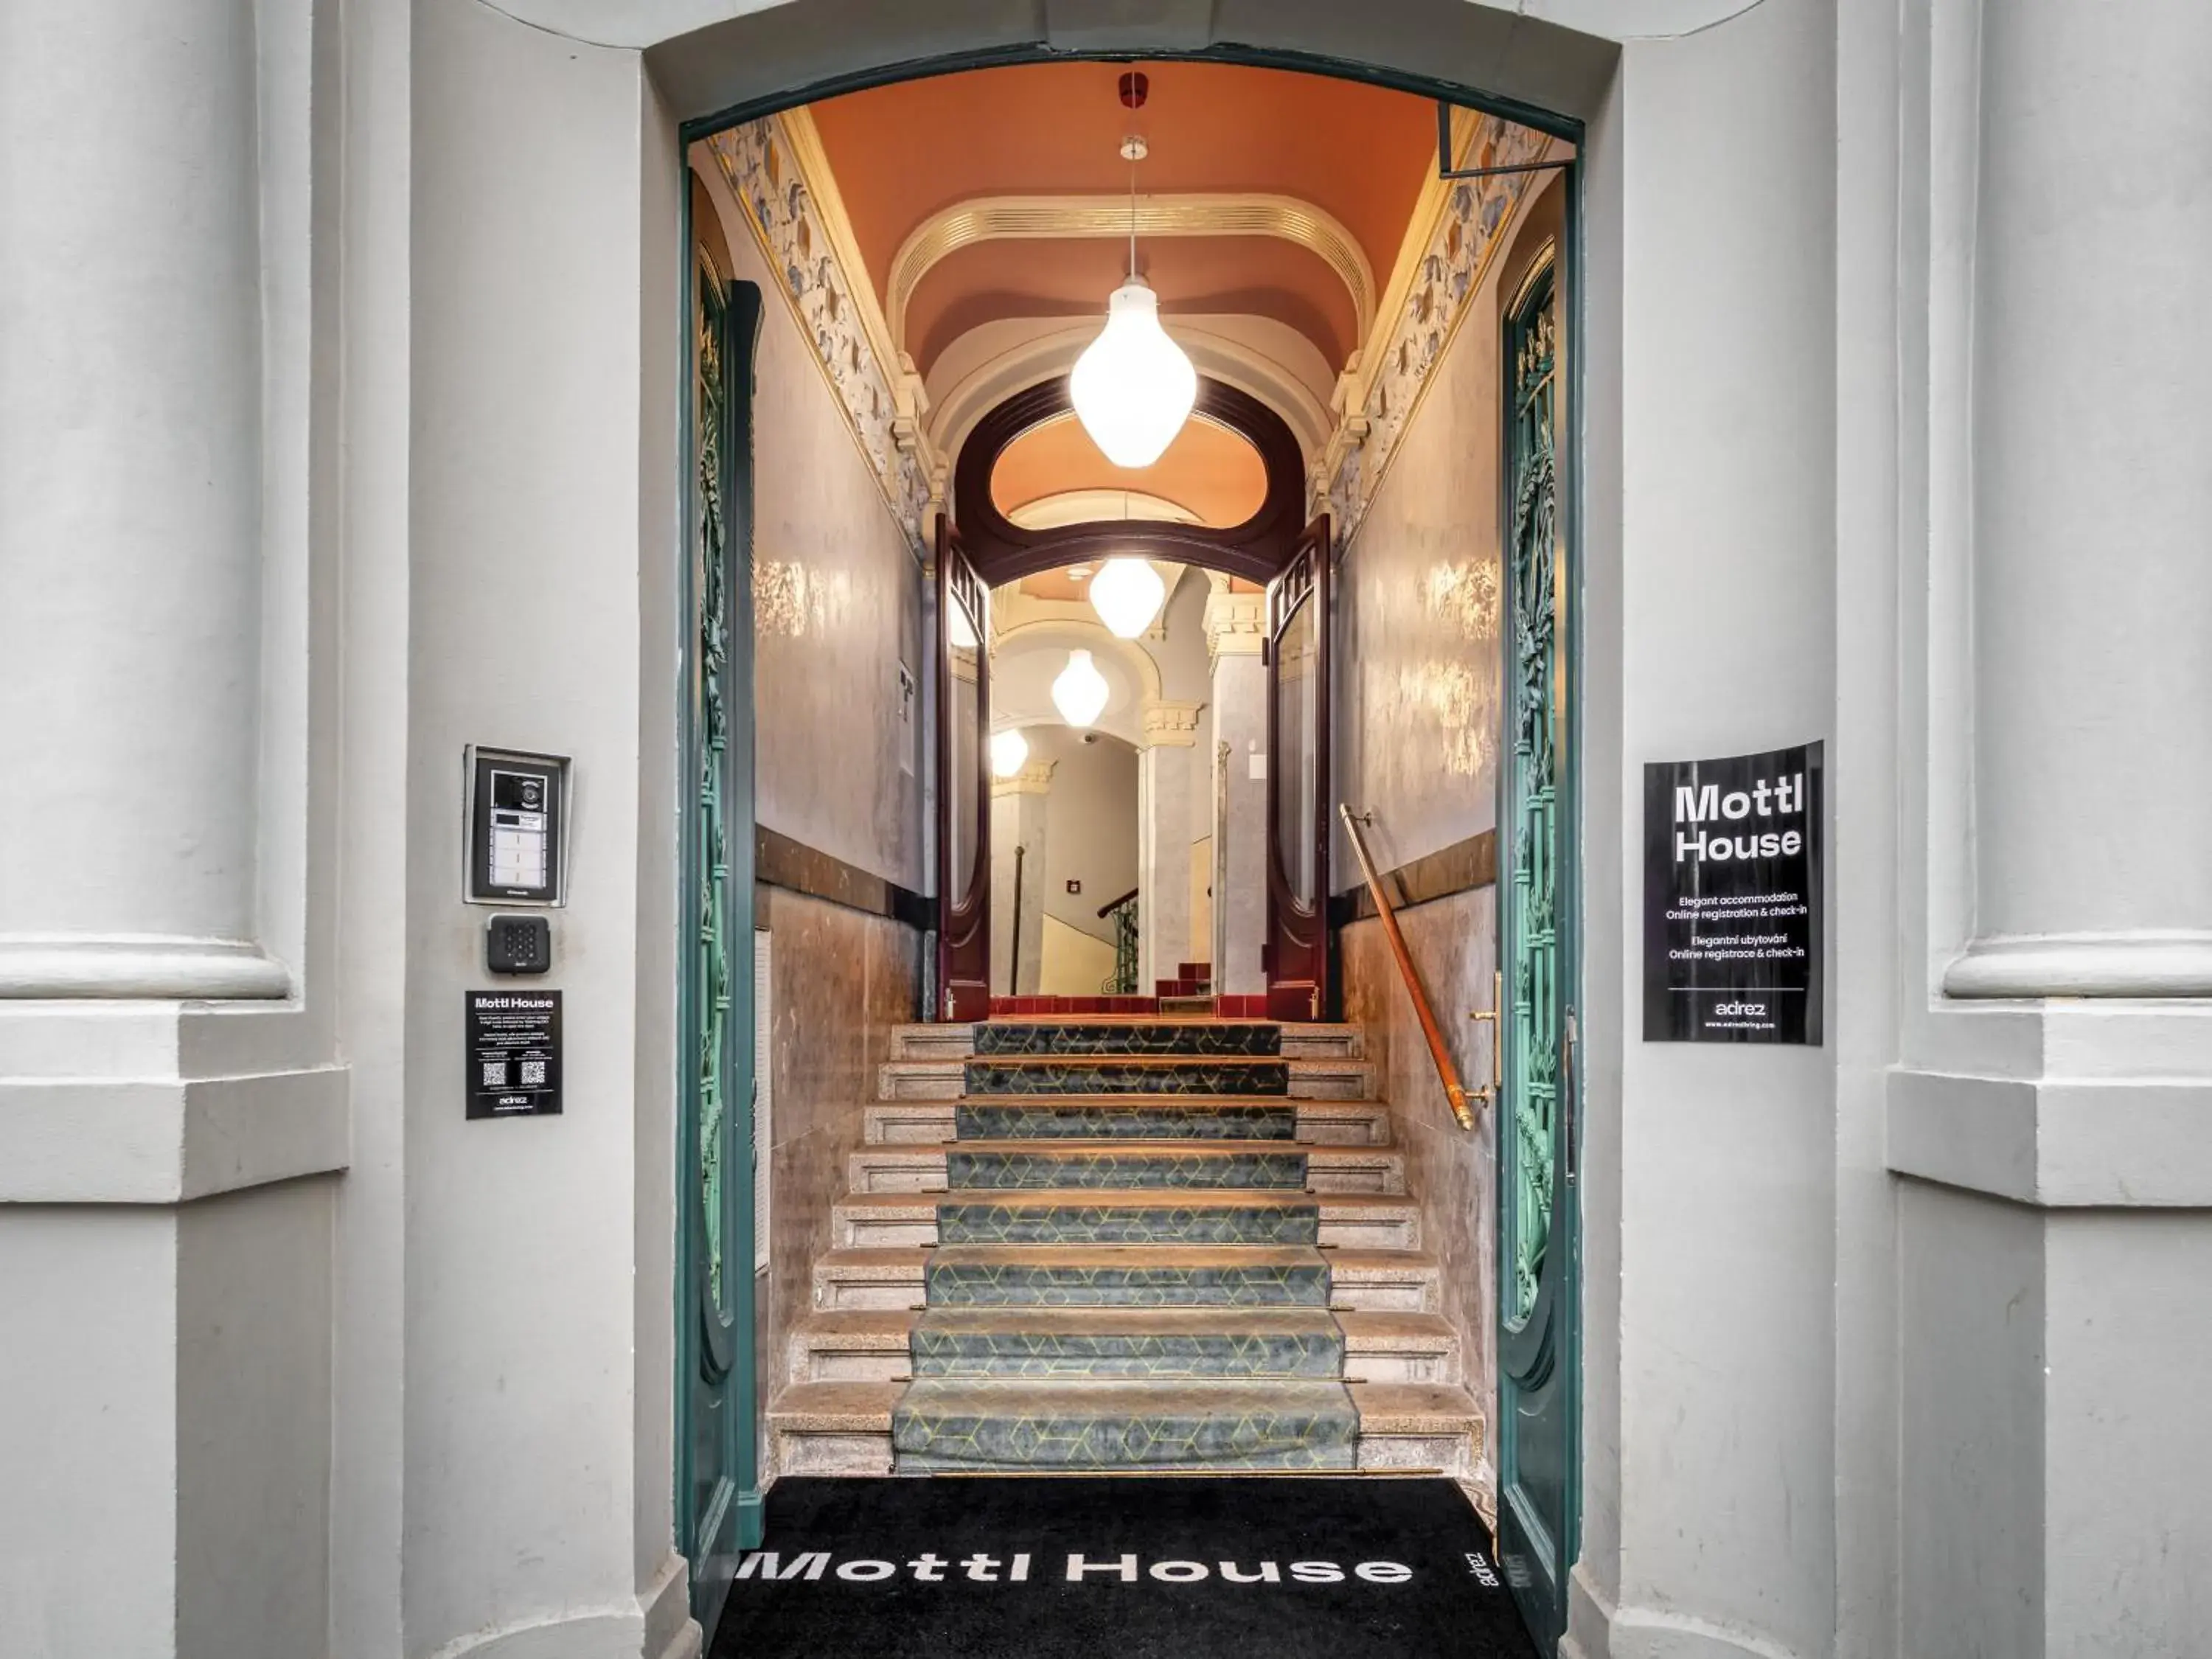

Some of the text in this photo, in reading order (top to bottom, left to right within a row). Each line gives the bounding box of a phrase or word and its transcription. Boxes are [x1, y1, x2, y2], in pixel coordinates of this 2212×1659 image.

[1676, 773, 1803, 823] Mottl
[1676, 830, 1801, 862] House
[1679, 892, 1798, 908] Elegant accommodation
[1666, 904, 1807, 921] Online registration & check-in
[1691, 933, 1788, 947] Elegantní ubytování
[1669, 946, 1805, 961] Online registrace & check-in
[476, 998, 554, 1008] Mottl House
[1716, 1001, 1766, 1015] adrez
[734, 1552, 1413, 1582] Mottl House
[1464, 1552, 1500, 1587] adrez
